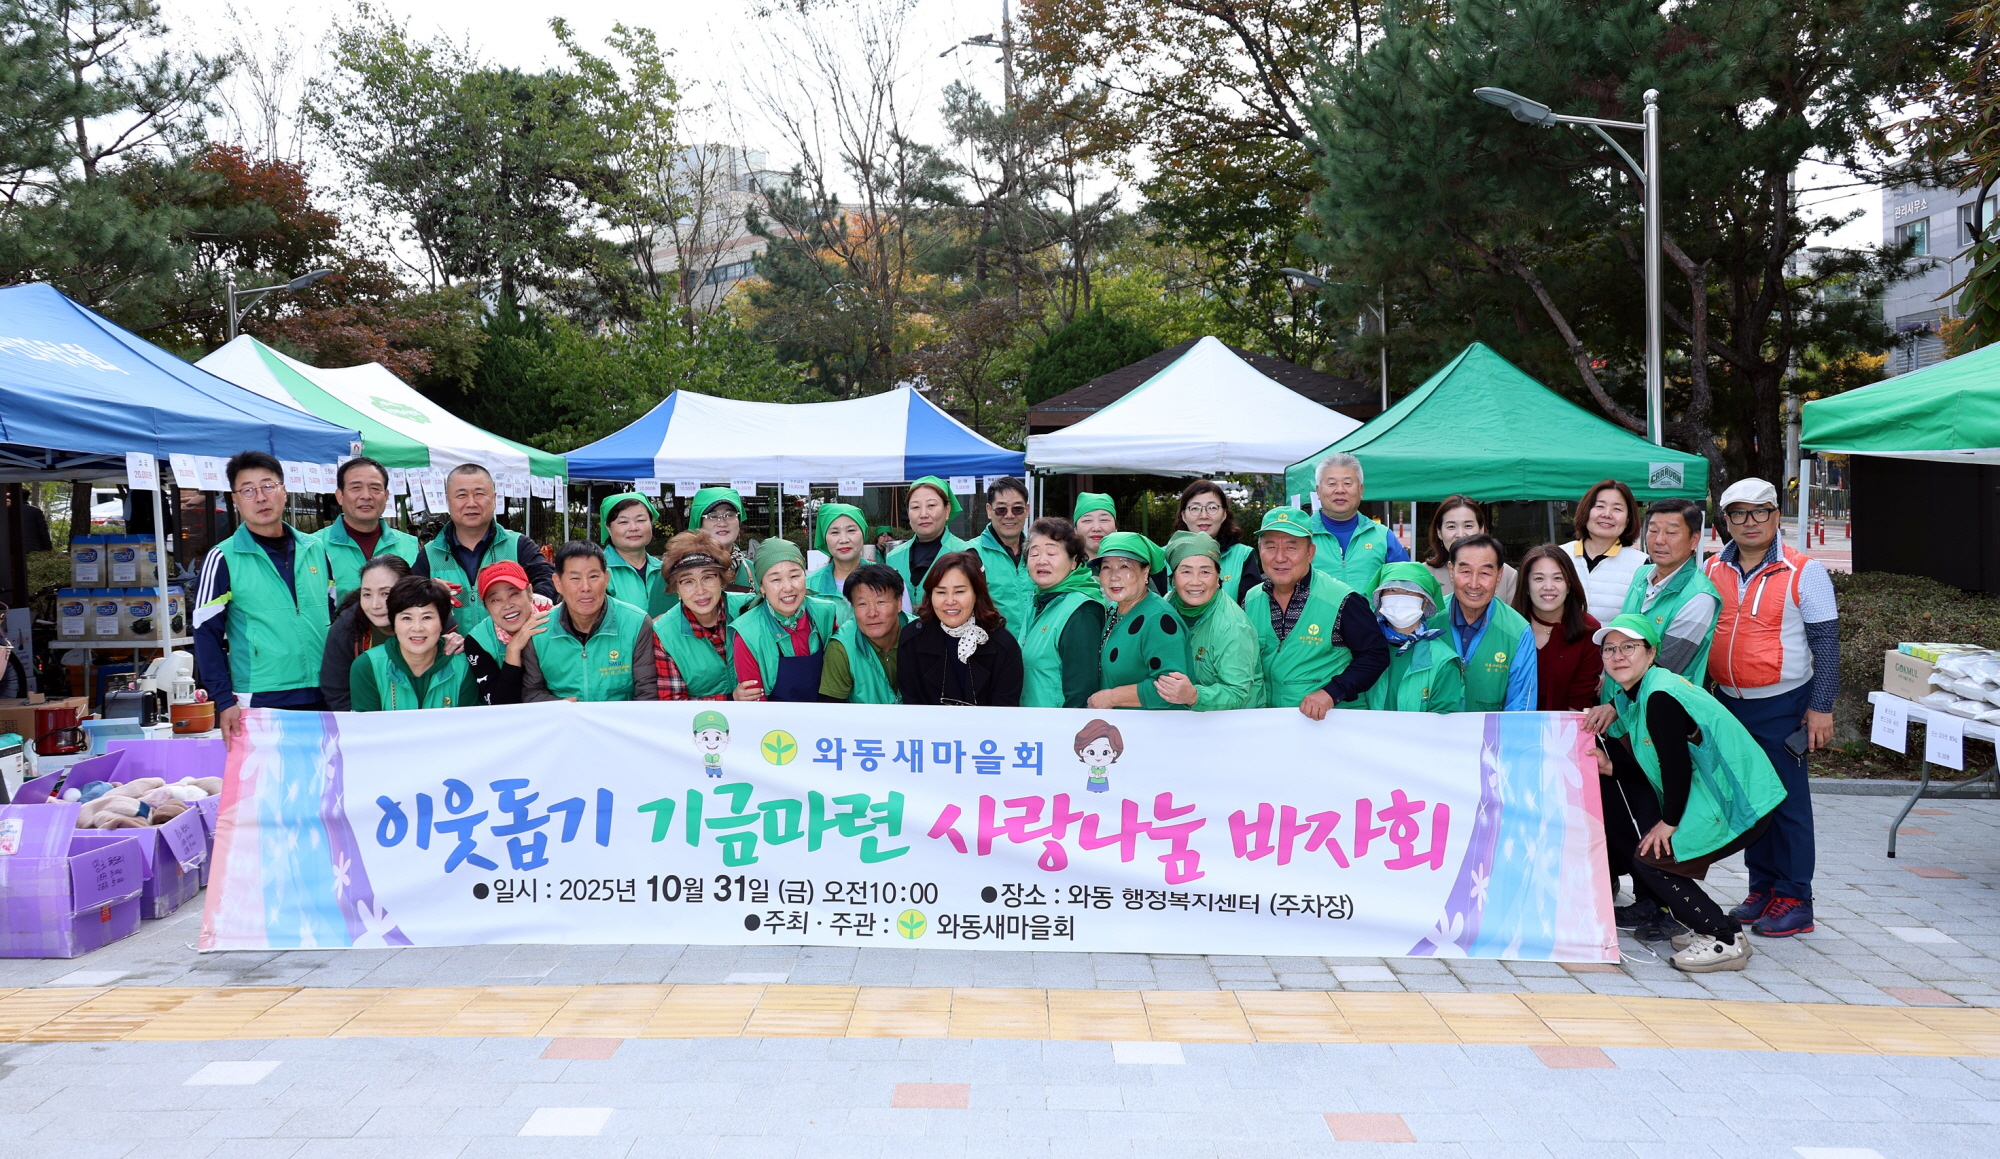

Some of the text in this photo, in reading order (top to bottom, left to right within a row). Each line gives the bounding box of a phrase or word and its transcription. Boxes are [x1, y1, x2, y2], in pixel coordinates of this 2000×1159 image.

[1894, 197, 1928, 220] 관리사무소
[1650, 467, 1682, 484] CARAVAN
[812, 737, 1044, 776] 와동새마을회
[375, 778, 1450, 885] 이웃돕기 기금마련 사랑나눔 바자회
[493, 878, 537, 903] 일시
[559, 878, 636, 903] 2025년
[647, 874, 703, 903] 10월
[713, 874, 769, 903] 31일
[778, 879, 814, 906] (금)
[822, 880, 939, 905] 오전10:00
[1001, 882, 1047, 908] 장소
[1067, 884, 1114, 910] 와동
[1122, 887, 1260, 915] 행정복지센터
[1270, 893, 1354, 920] (주차장)
[763, 910, 809, 935] 주최
[829, 912, 877, 937] 주관
[936, 913, 1074, 941] 와동새마을회
